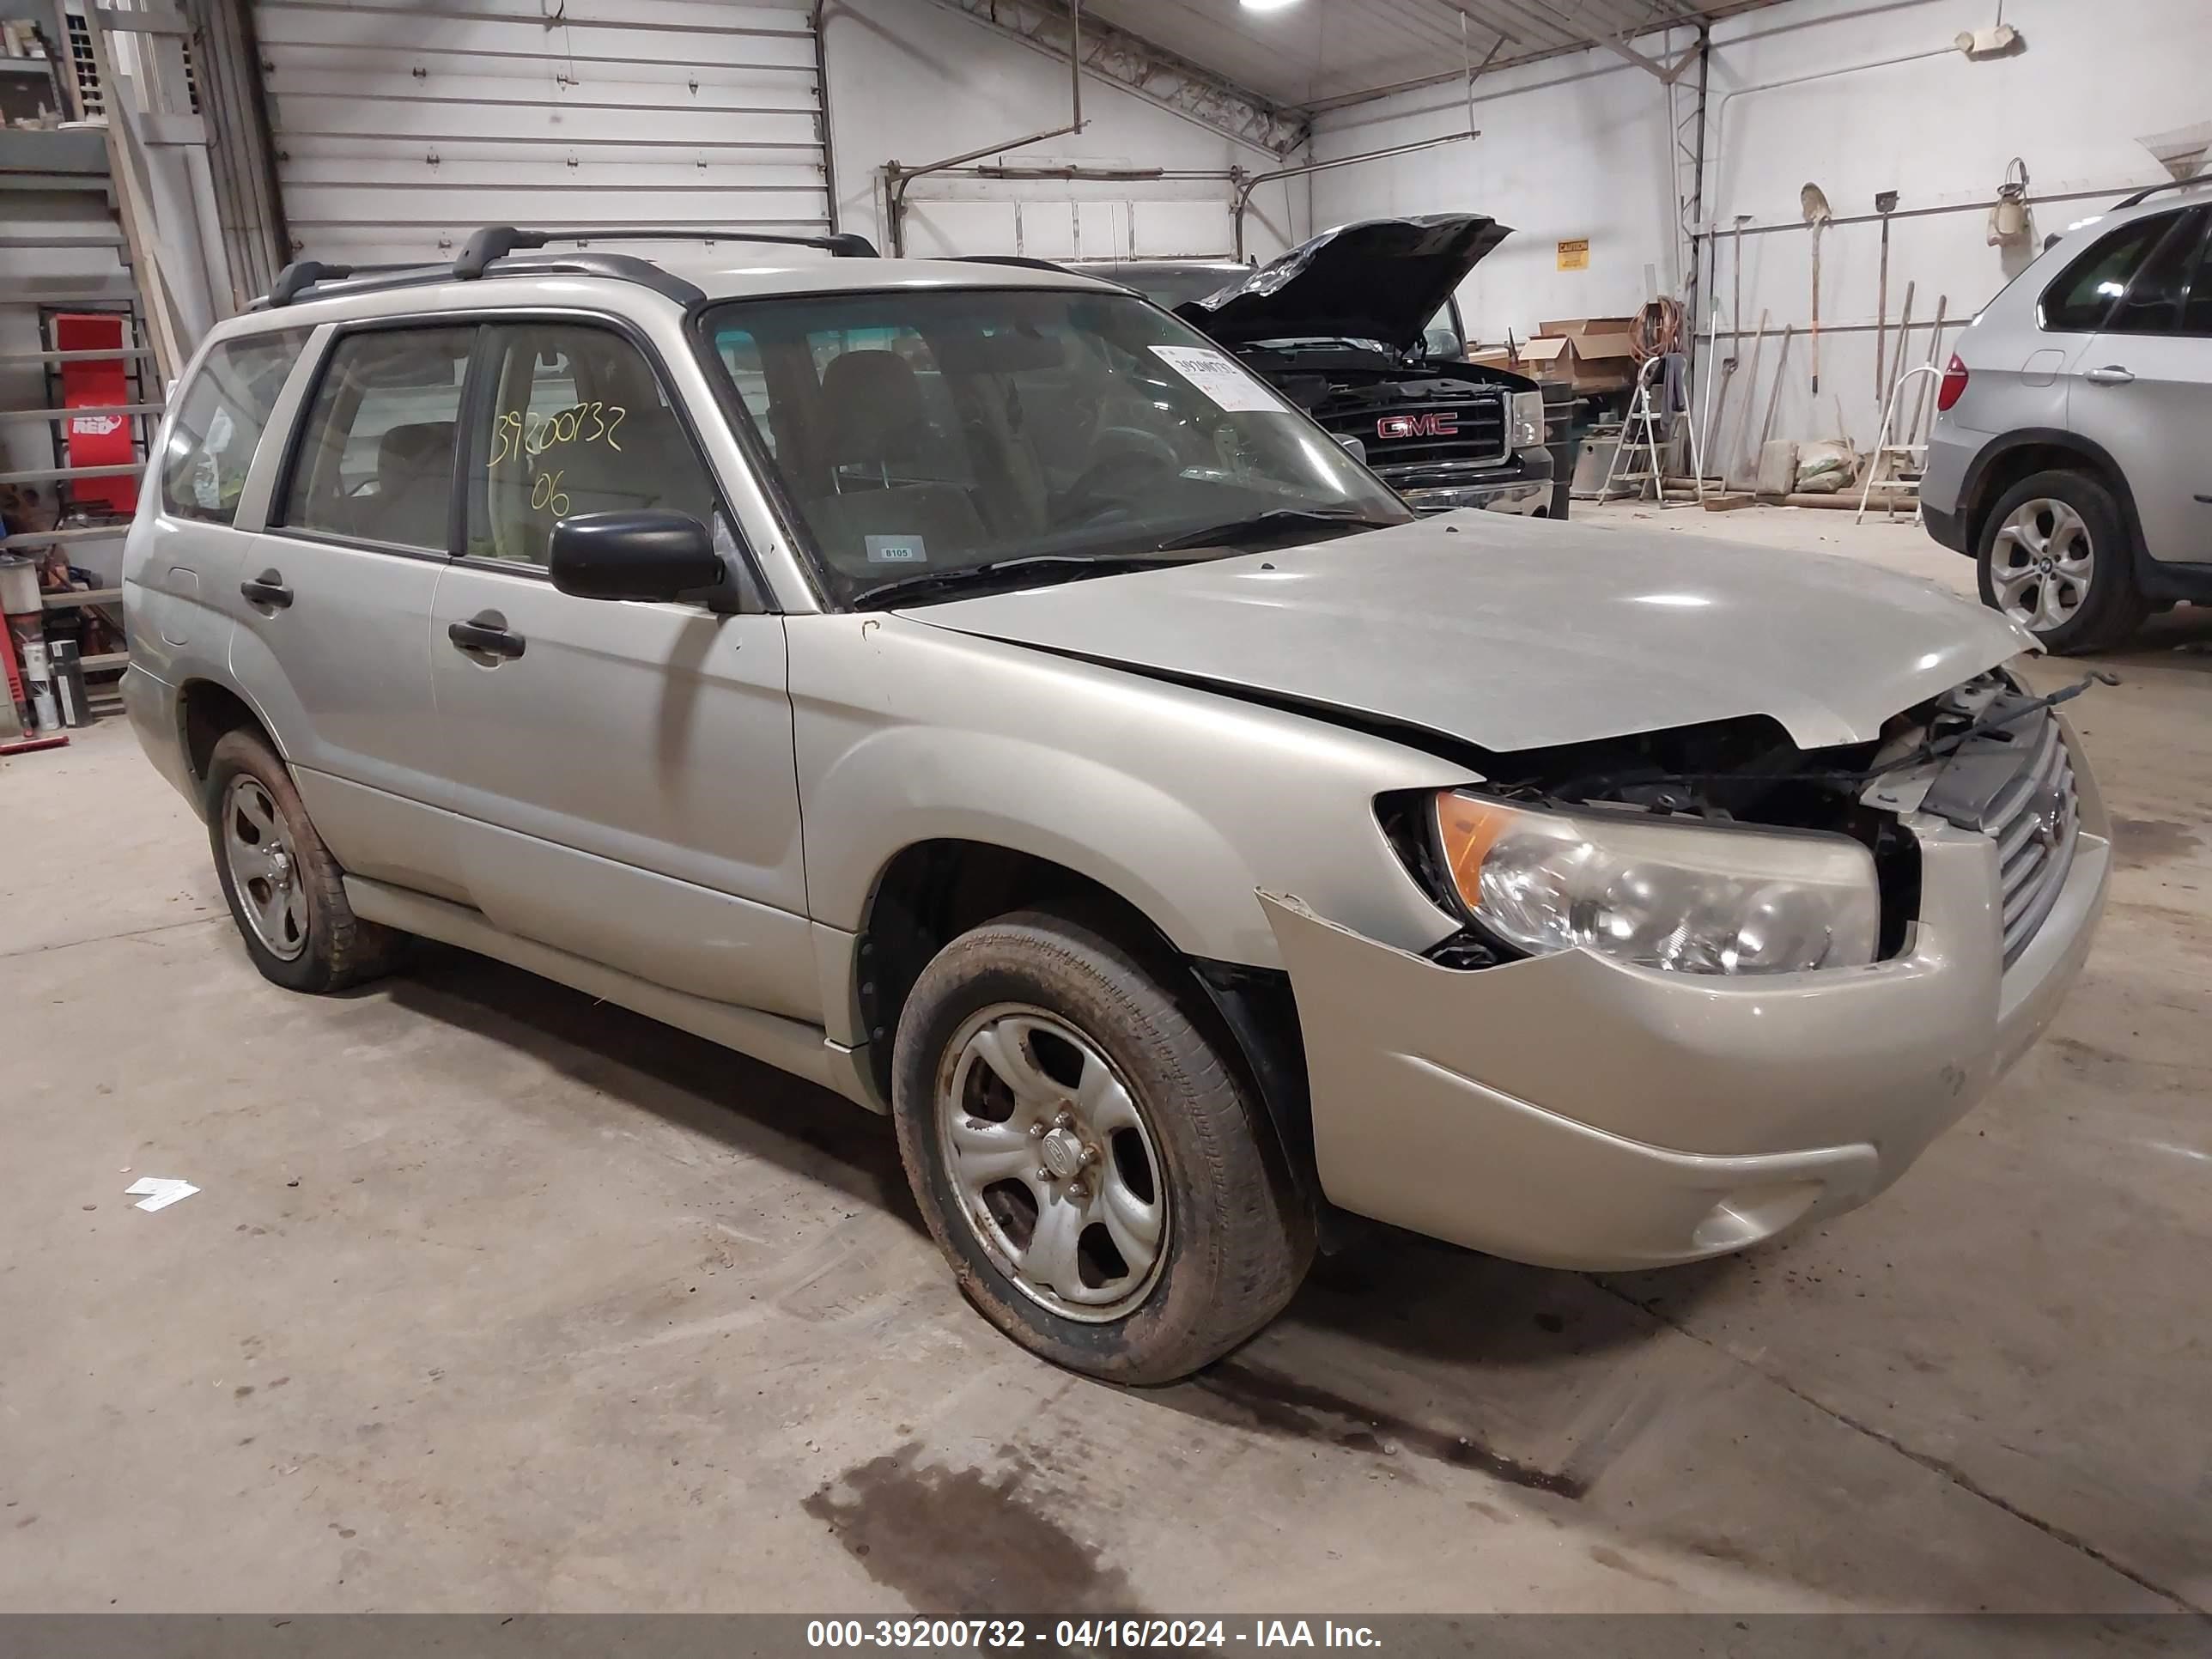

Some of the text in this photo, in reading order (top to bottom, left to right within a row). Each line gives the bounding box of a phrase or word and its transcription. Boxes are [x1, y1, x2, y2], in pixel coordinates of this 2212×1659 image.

[487, 402, 626, 467] 39200732
[1377, 412, 1458, 439] GMC
[532, 470, 570, 517] 06
[885, 549, 908, 557] 8105
